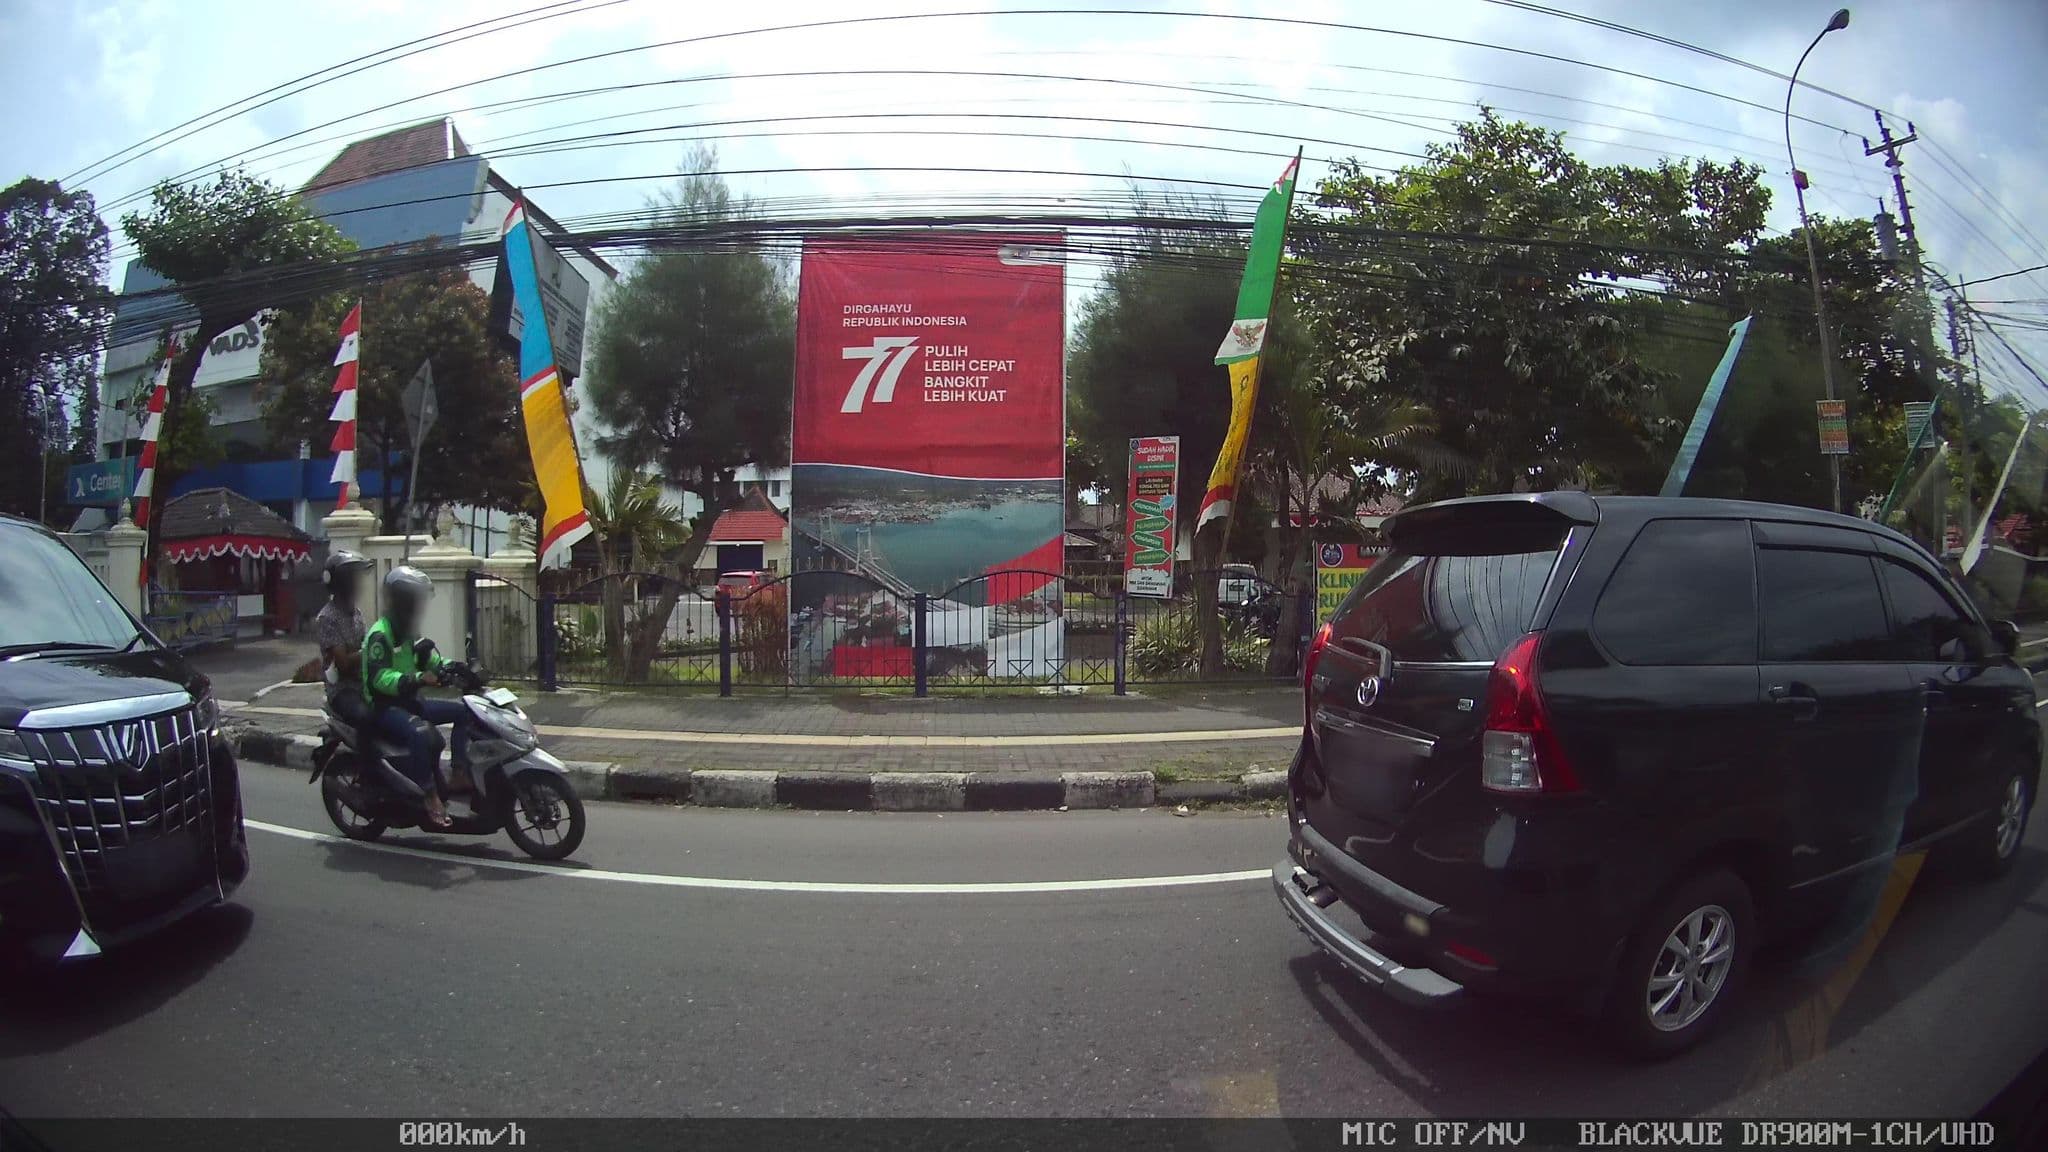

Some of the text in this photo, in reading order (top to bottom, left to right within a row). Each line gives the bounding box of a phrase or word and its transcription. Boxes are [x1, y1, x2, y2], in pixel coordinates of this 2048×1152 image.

[843, 304, 912, 314] DIRGAHAYU
[843, 316, 967, 328] REPUBLIK INDONESIA
[925, 346, 968, 357] PULIH
[924, 360, 1016, 372] LEBIH CEPAT
[840, 336, 920, 413] 77
[924, 376, 989, 388] BANGKIT
[924, 390, 1007, 402] LEBIH KUAT
